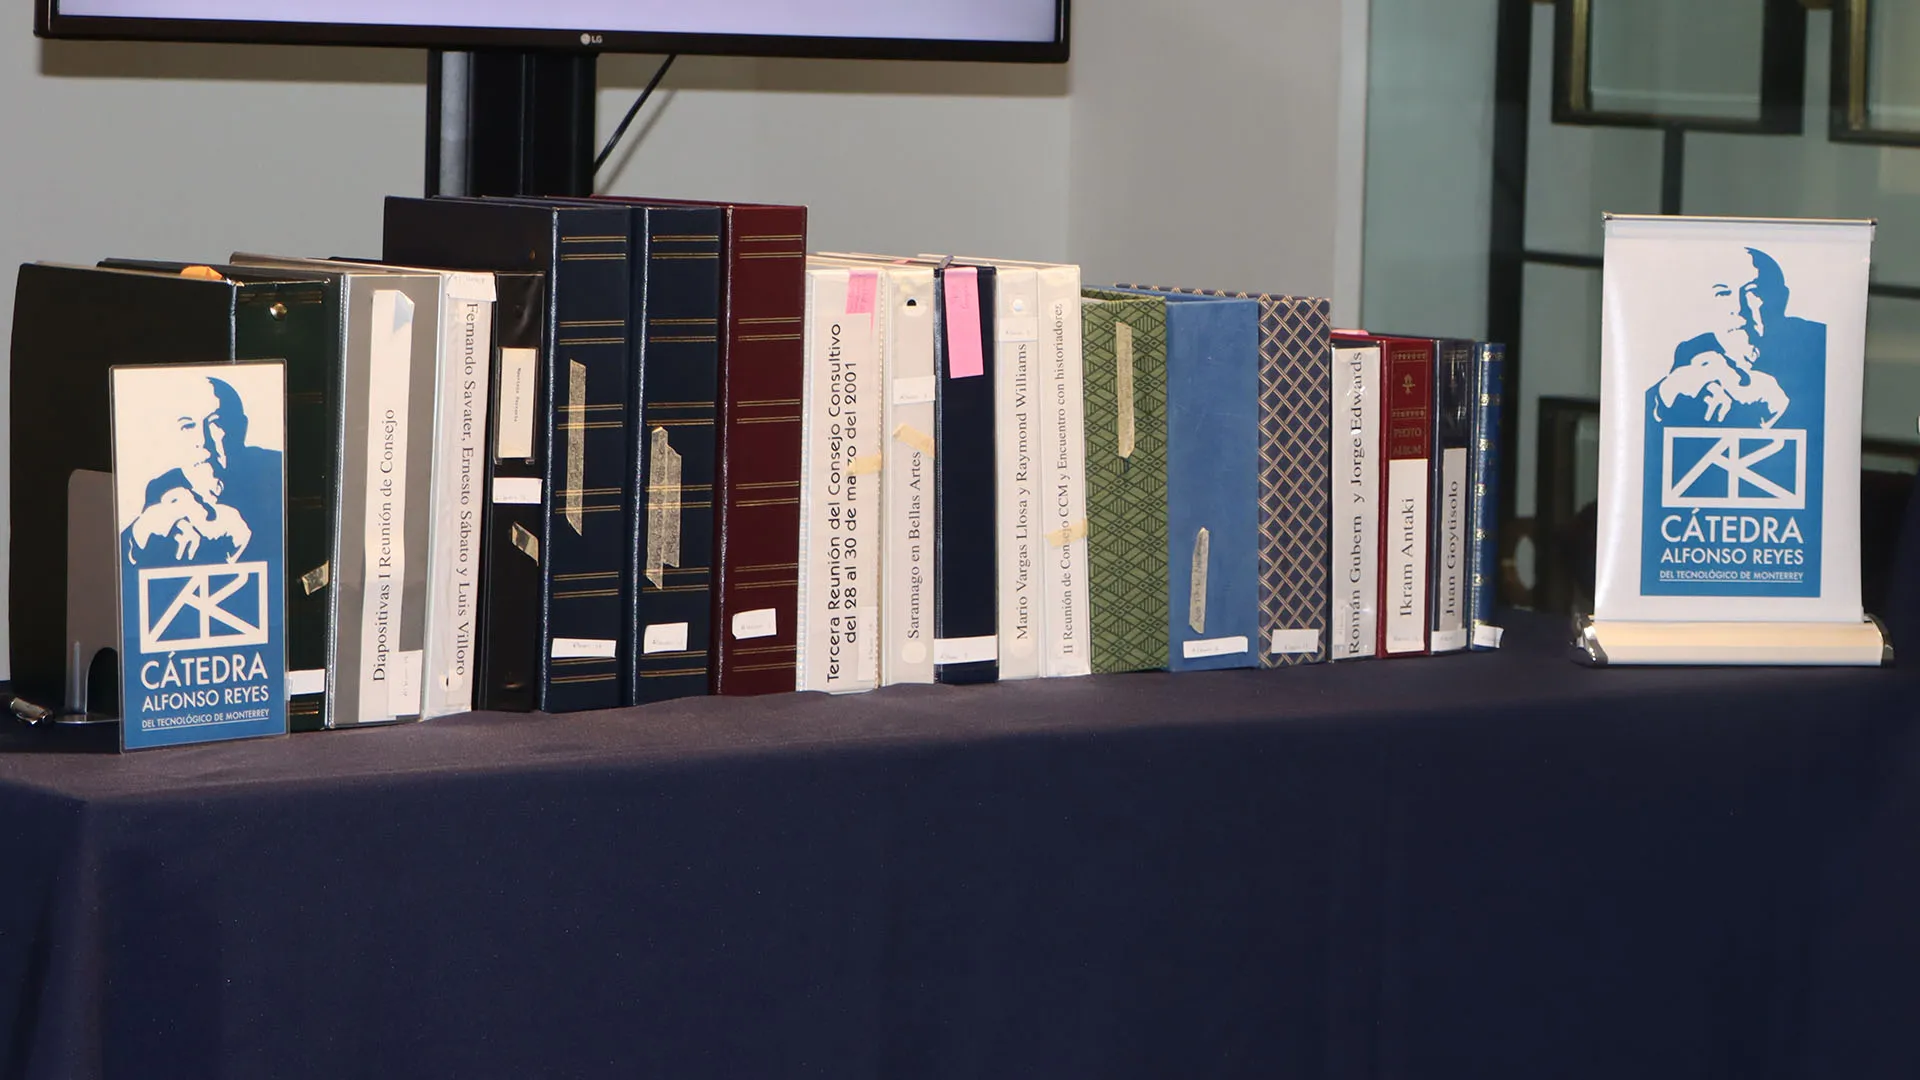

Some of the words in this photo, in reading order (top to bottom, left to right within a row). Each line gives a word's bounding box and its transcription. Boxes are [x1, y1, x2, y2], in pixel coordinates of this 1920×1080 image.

[591, 34, 603, 44] LG
[464, 303, 478, 376] Fernando
[828, 323, 841, 417] Consultivo
[844, 363, 857, 404] 2001
[1016, 343, 1028, 408] Williams
[460, 380, 476, 441] Savater,
[1057, 383, 1066, 405] con
[1350, 352, 1362, 431] Edwards
[380, 409, 398, 474] Consejo
[844, 412, 856, 439] del
[1056, 408, 1068, 470] Encuentro
[828, 424, 843, 495] Consejo
[1016, 413, 1030, 481] Raymond
[1351, 438, 1365, 486] Jorge
[380, 479, 392, 497] de
[461, 447, 474, 505] Ernesto
[909, 451, 921, 491] Artes
[1019, 487, 1030, 495] y
[1060, 474, 1071, 482] y
[828, 502, 840, 530] del
[909, 495, 920, 540] Bellas
[1058, 484, 1069, 517] CCM
[1353, 493, 1365, 503] y
[378, 503, 391, 567] Reunión
[459, 510, 472, 563] Sábato
[844, 508, 856, 531] de
[1016, 500, 1028, 539] Llosa
[1401, 498, 1415, 557] Antaki
[1447, 481, 1459, 569] Goytisolo
[1661, 507, 1804, 544] CÁTEDRA
[844, 537, 857, 559] 30
[911, 545, 920, 562] en
[1016, 544, 1030, 592] Vargas
[1350, 515, 1362, 583] Gubern
[1660, 547, 1747, 565] ALFONSO
[1752, 549, 1804, 565] REYES
[456, 568, 468, 577] y
[828, 537, 840, 610] Reunión
[844, 566, 856, 580] al
[1061, 573, 1072, 587] de
[1400, 563, 1413, 616] Ikram
[1660, 570, 1675, 579] DEL
[1676, 568, 1738, 580] TECNOLÓGICO
[1740, 571, 1751, 580] DE
[1753, 571, 1804, 581] MONTERREY
[457, 583, 470, 616] Luis
[844, 587, 857, 609] 28
[907, 567, 923, 639] Saramago
[1061, 590, 1073, 640] Reunión
[1445, 576, 1456, 616] Juan
[373, 584, 391, 681] Diapositivas
[844, 616, 856, 643] del
[1016, 596, 1028, 639] Mario
[1349, 590, 1361, 654] Román
[456, 622, 469, 676] Villoro
[827, 617, 840, 683] Tercera
[140, 651, 268, 690] CÁTEDRA
[142, 689, 220, 713] ALFONSO
[224, 685, 269, 705] REYES
[142, 719, 155, 729] DEL
[157, 713, 212, 727] TECNOLÓGICO
[214, 713, 224, 722] DE
[225, 708, 270, 721] MONTERREY
